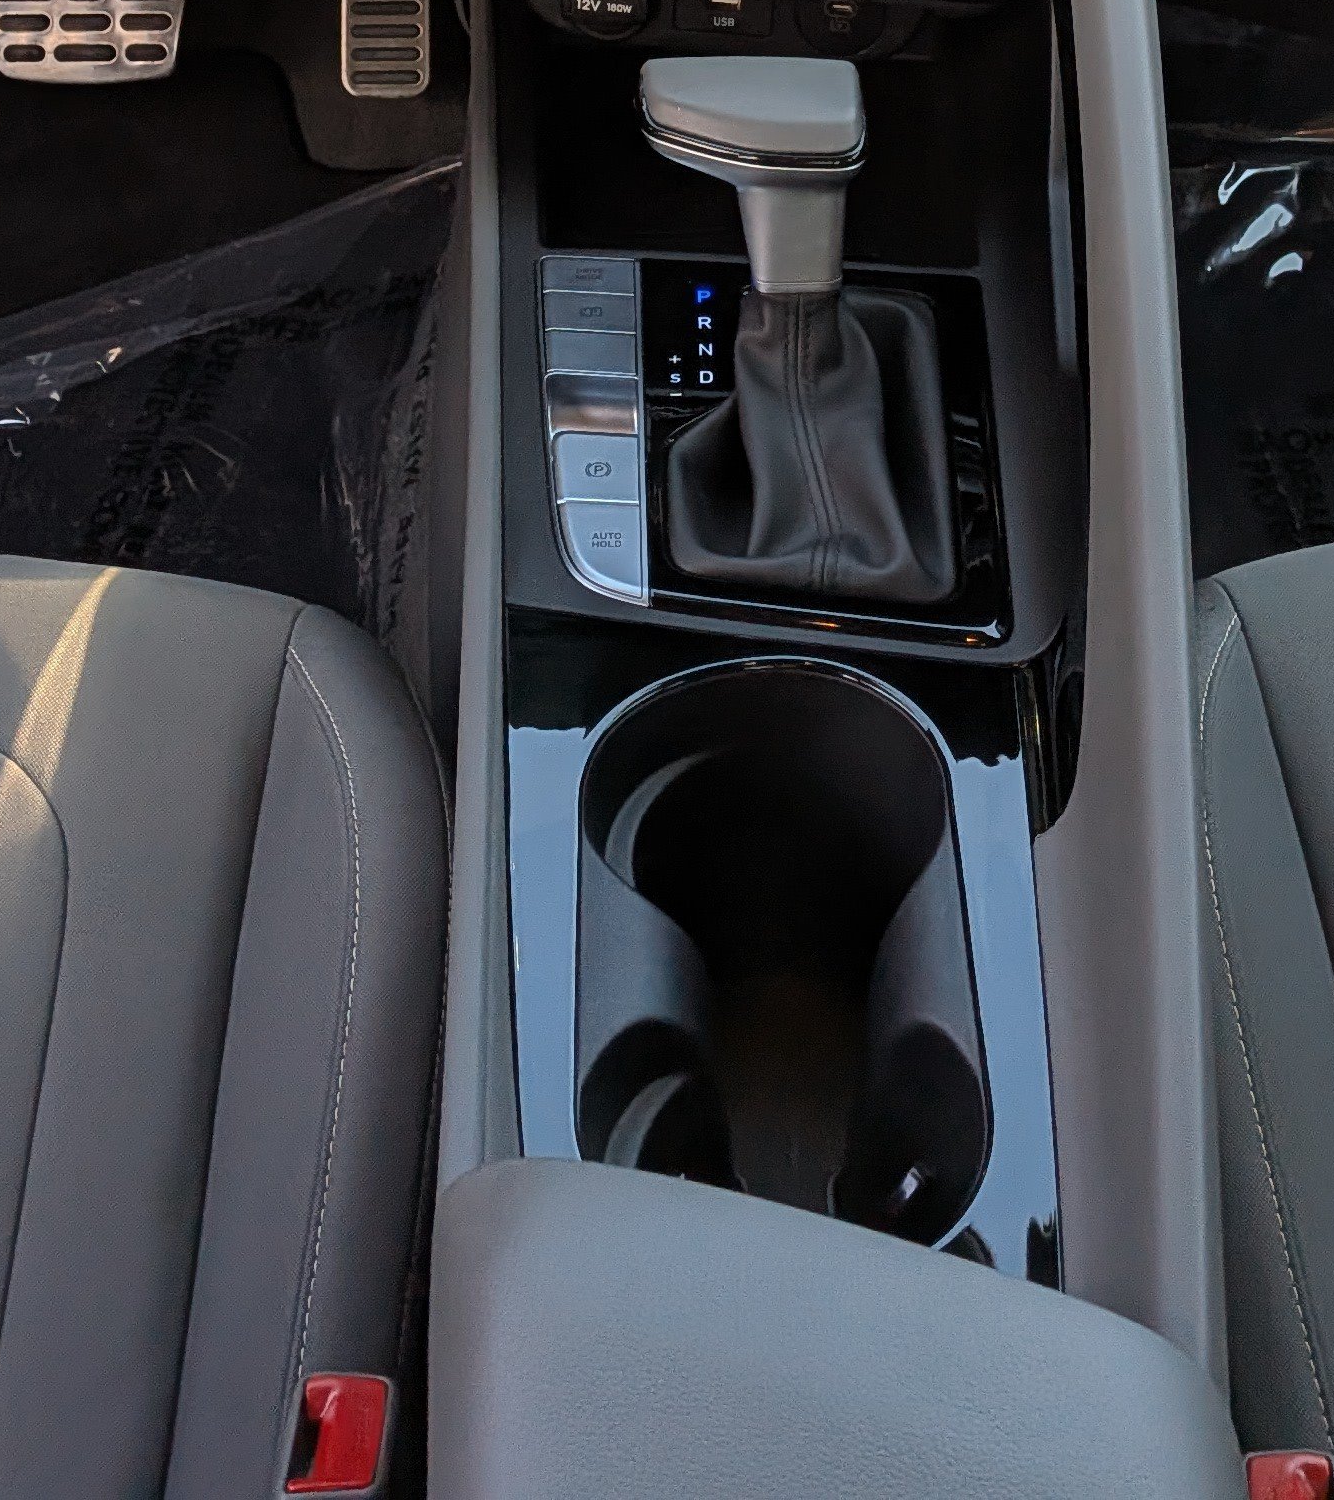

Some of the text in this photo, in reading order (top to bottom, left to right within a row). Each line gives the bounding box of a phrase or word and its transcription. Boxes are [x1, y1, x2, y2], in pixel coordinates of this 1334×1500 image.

[713, 16, 736, 28] USB
[697, 289, 711, 303] P
[697, 316, 712, 330] R
[698, 343, 713, 356] N
[699, 370, 714, 384] D
[591, 532, 622, 540] AUTO
[591, 539, 622, 548] HOLD
